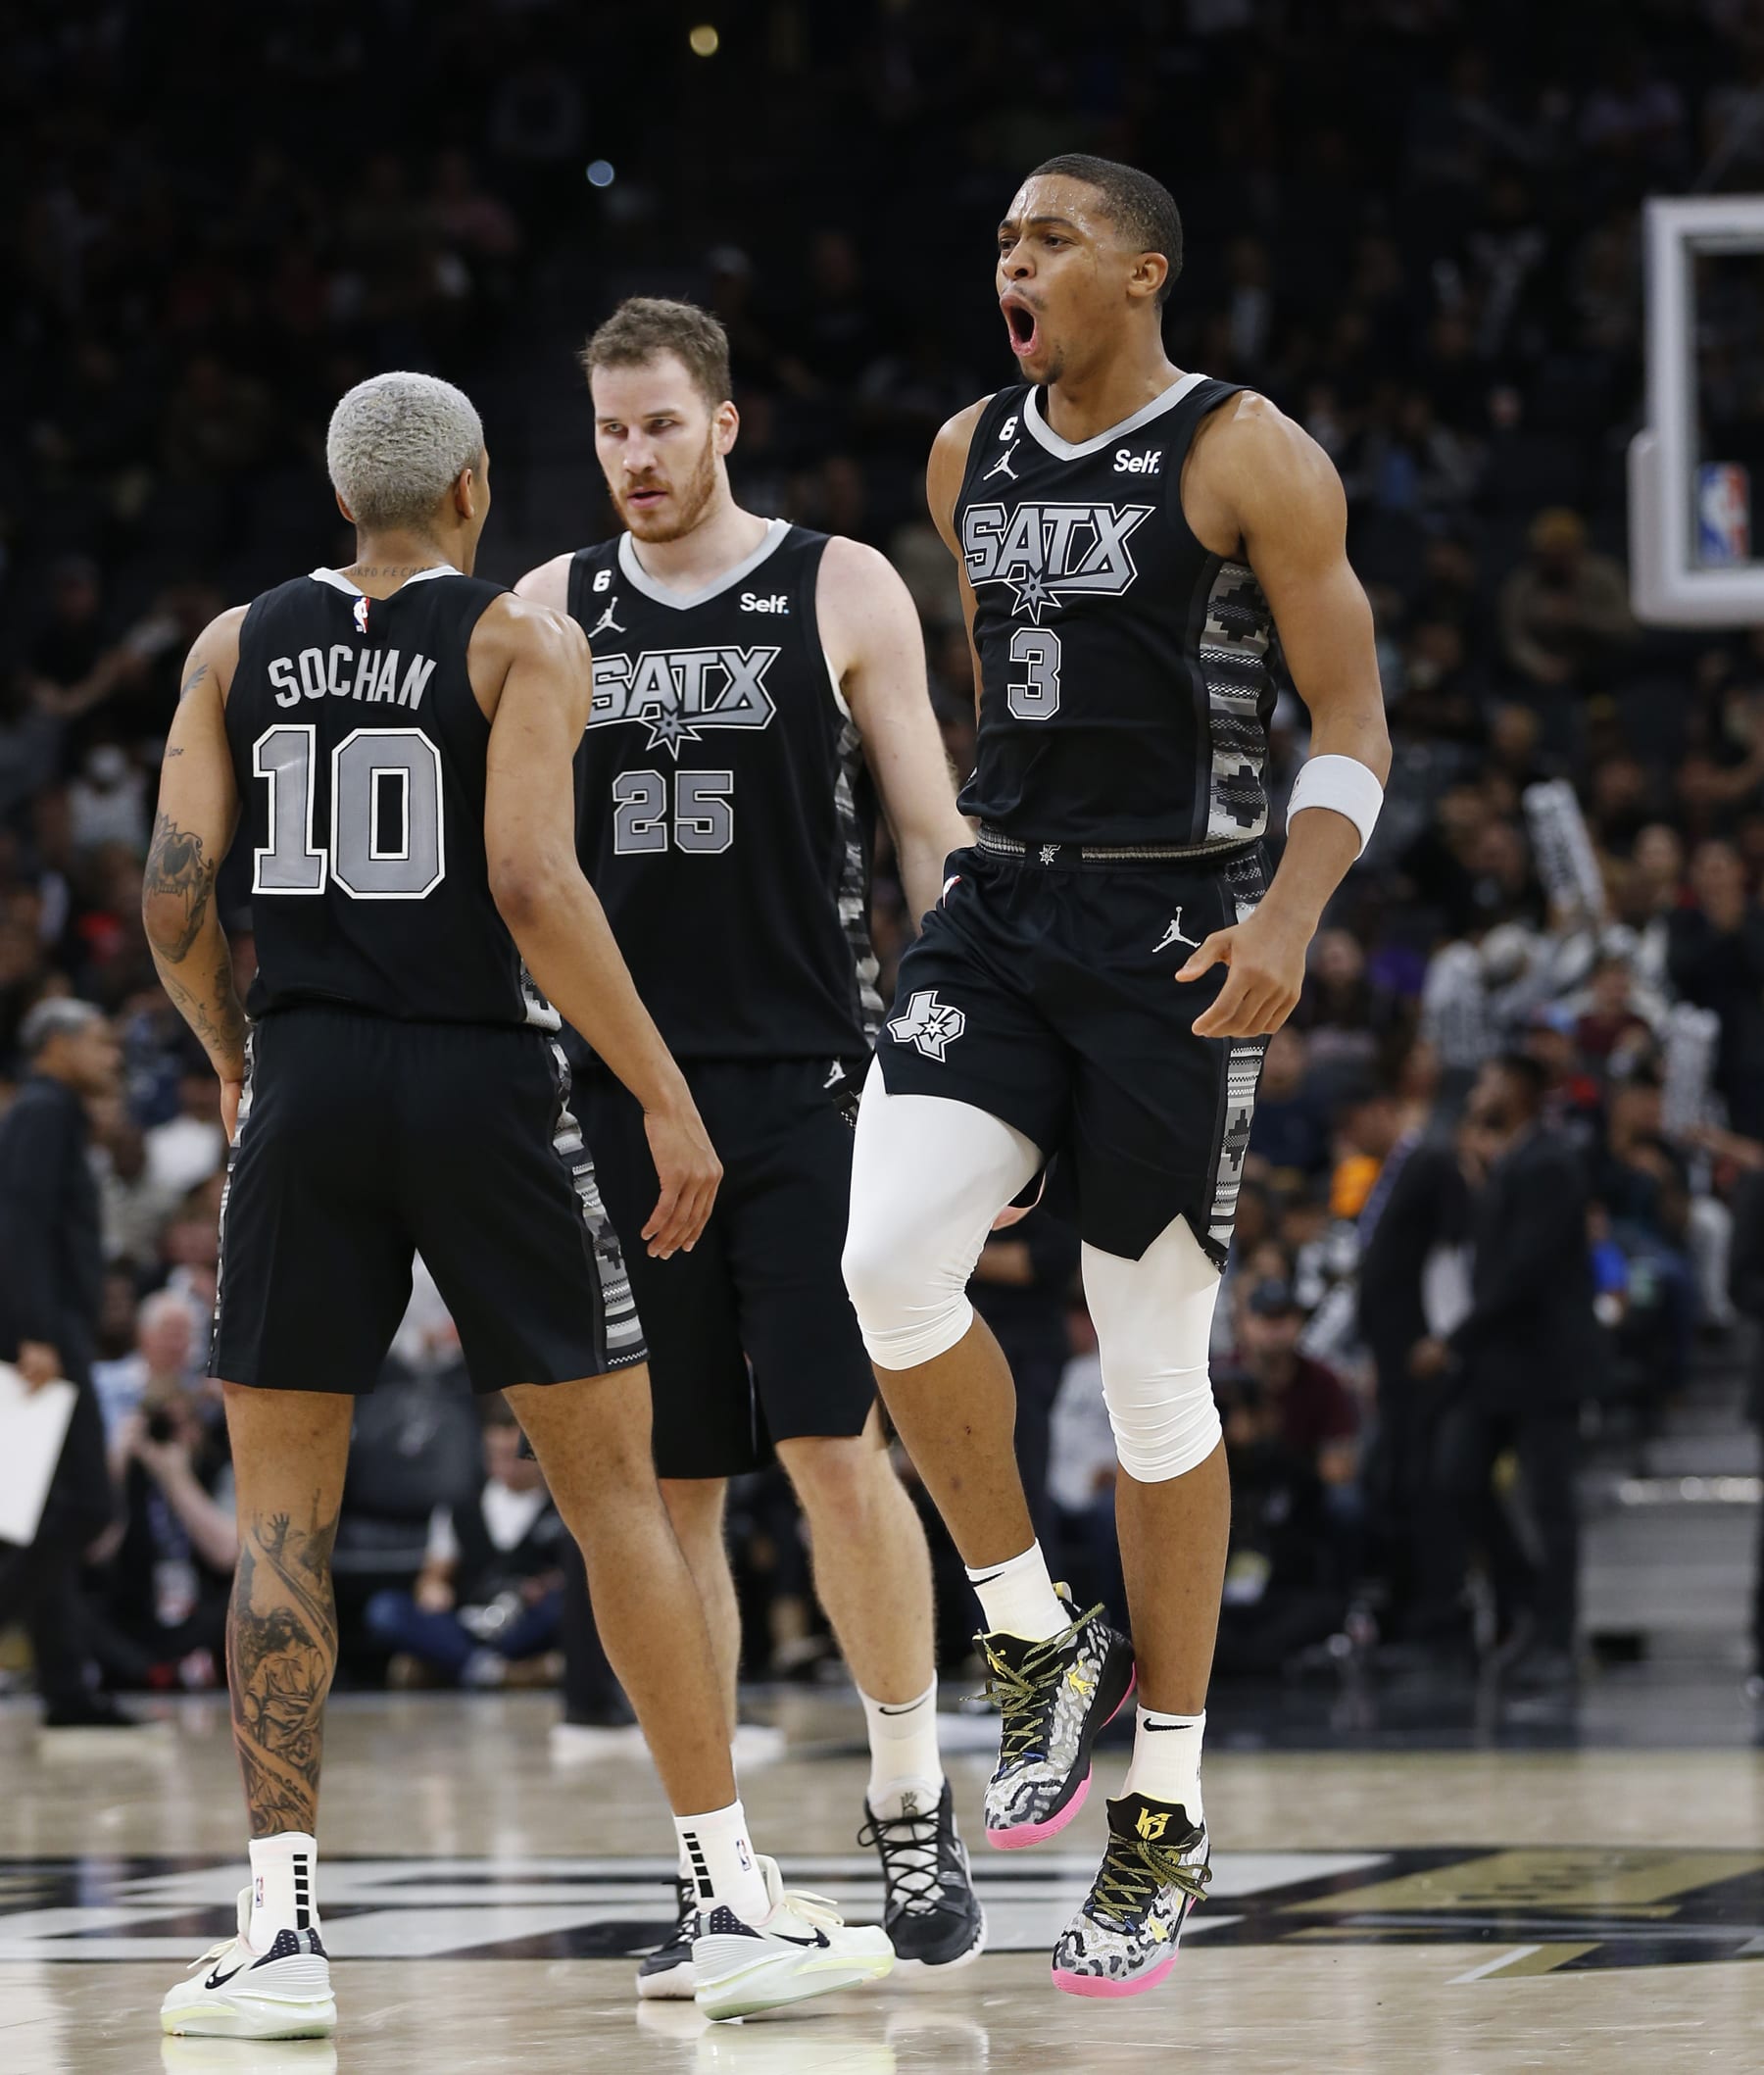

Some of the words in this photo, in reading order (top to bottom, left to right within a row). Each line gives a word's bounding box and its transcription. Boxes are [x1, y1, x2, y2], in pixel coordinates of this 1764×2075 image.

[998, 416, 1020, 441] 6
[1113, 448, 1162, 474] Self.
[592, 569, 612, 592] 6
[963, 501, 1156, 597] SATX
[739, 592, 790, 616] Self.
[267, 643, 437, 712] SOCHAN
[585, 645, 783, 730] SATX
[1006, 627, 1061, 721] 3
[251, 723, 447, 900] 10
[612, 768, 735, 856] 25
